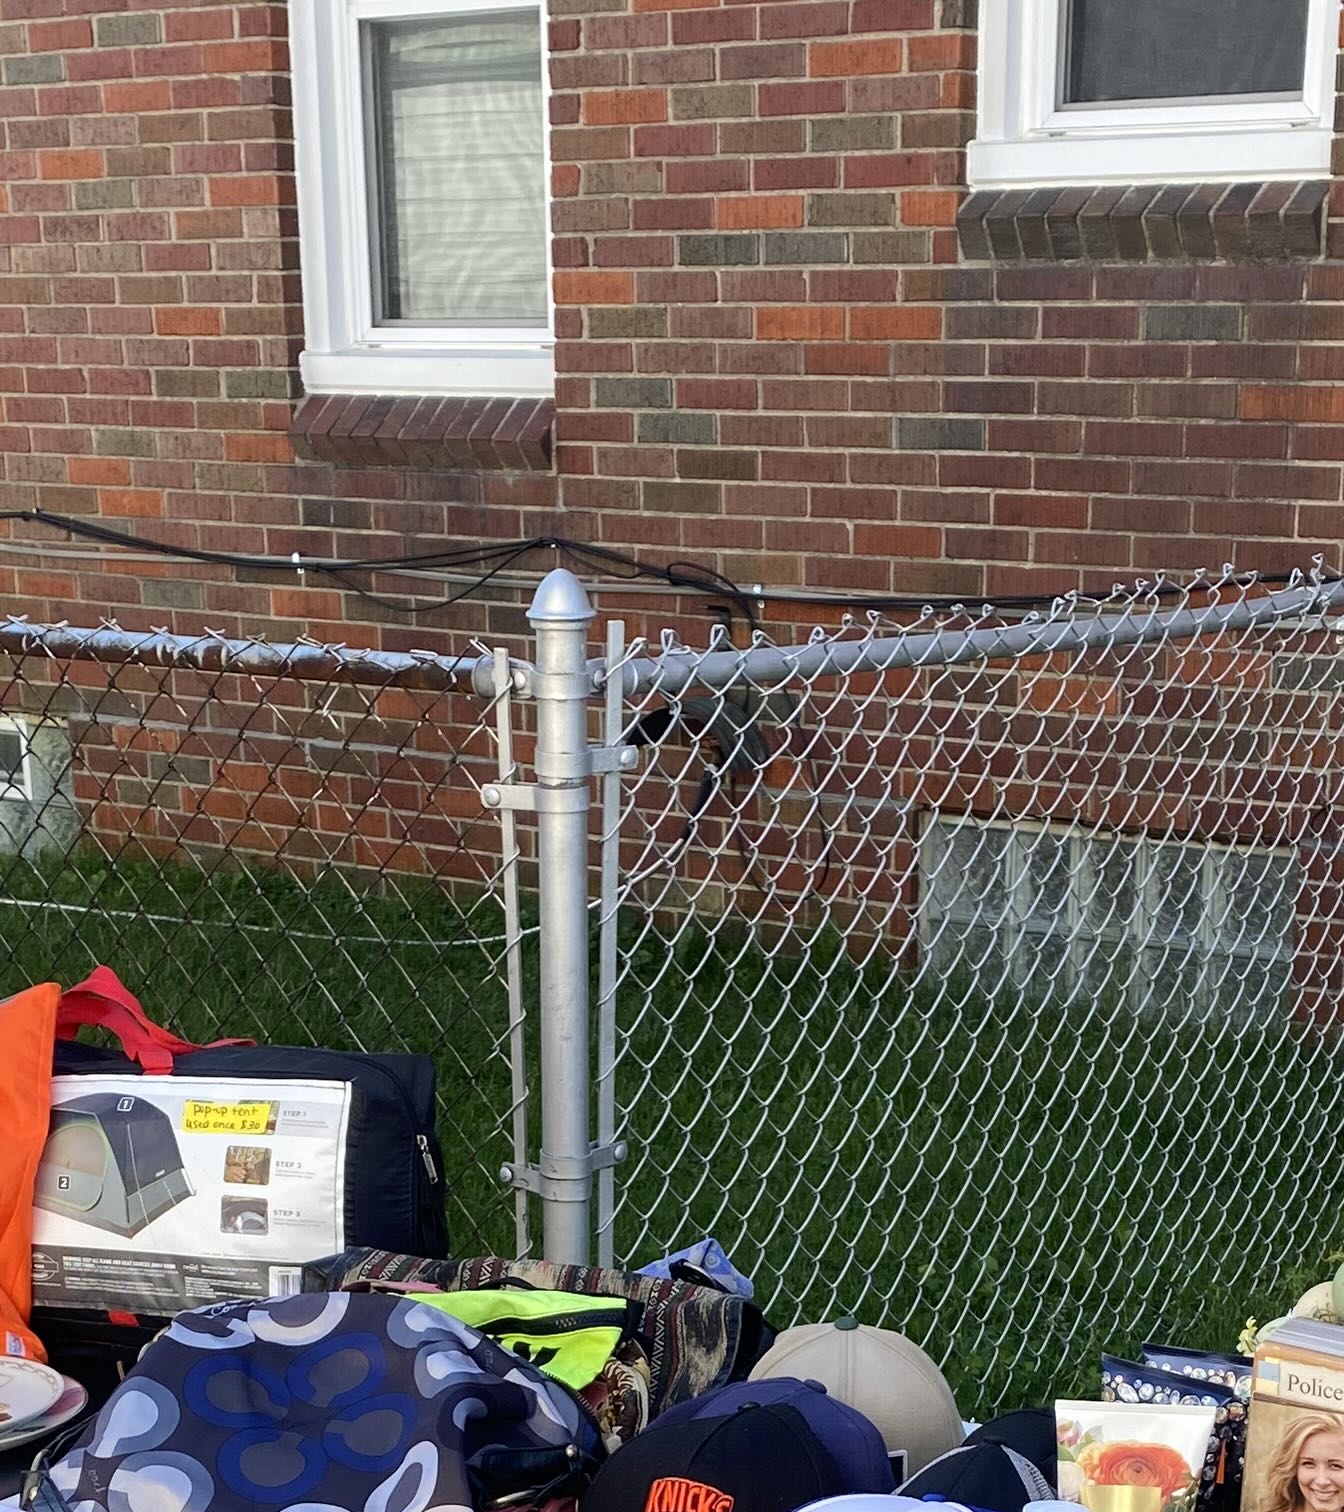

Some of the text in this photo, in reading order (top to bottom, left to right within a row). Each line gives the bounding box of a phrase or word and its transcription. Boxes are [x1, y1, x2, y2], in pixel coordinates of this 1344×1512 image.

[232, 1104, 259, 1116] tent
[185, 1119, 261, 1129] used once $30
[1286, 1373, 1344, 1402] Police
